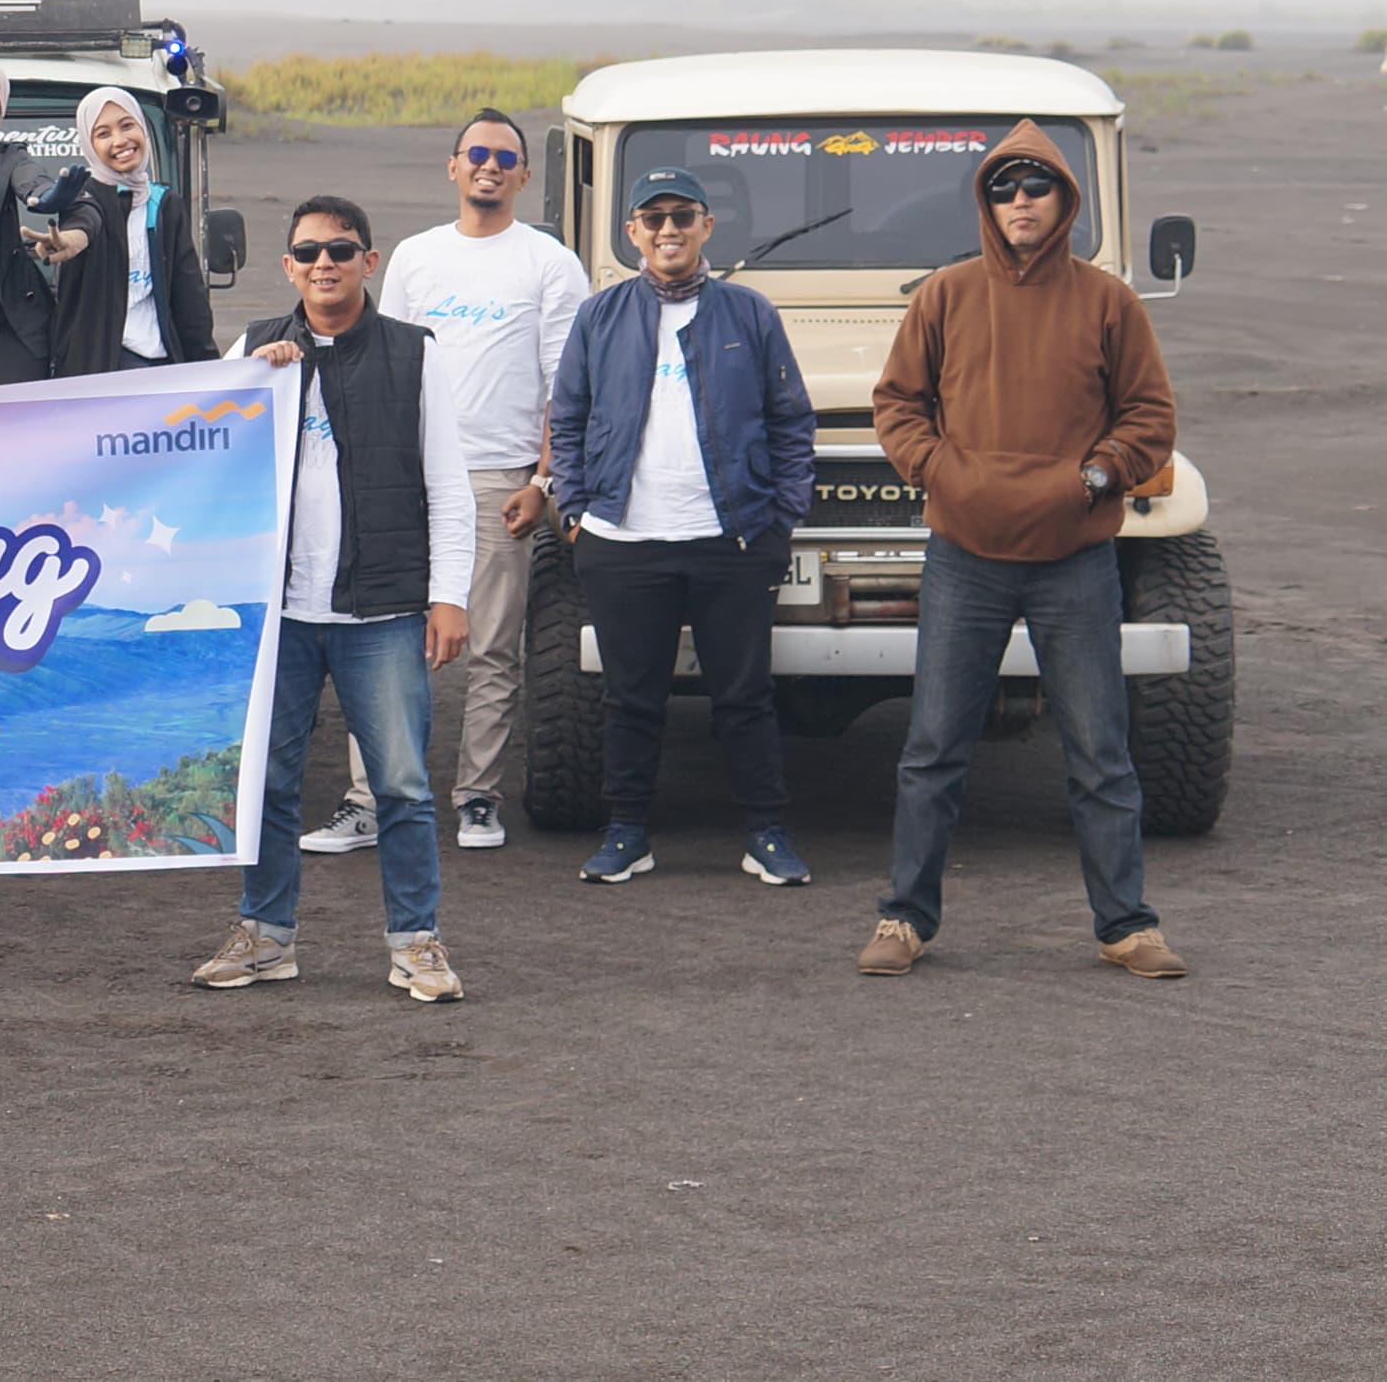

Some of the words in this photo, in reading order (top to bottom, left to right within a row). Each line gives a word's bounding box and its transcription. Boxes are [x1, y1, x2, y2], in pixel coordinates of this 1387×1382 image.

[709, 132, 812, 157] RAUNG
[883, 130, 987, 154] JEMBER
[425, 295, 507, 325] Lay's
[95, 421, 230, 456] mandiri
[815, 485, 929, 501] TOYOT
